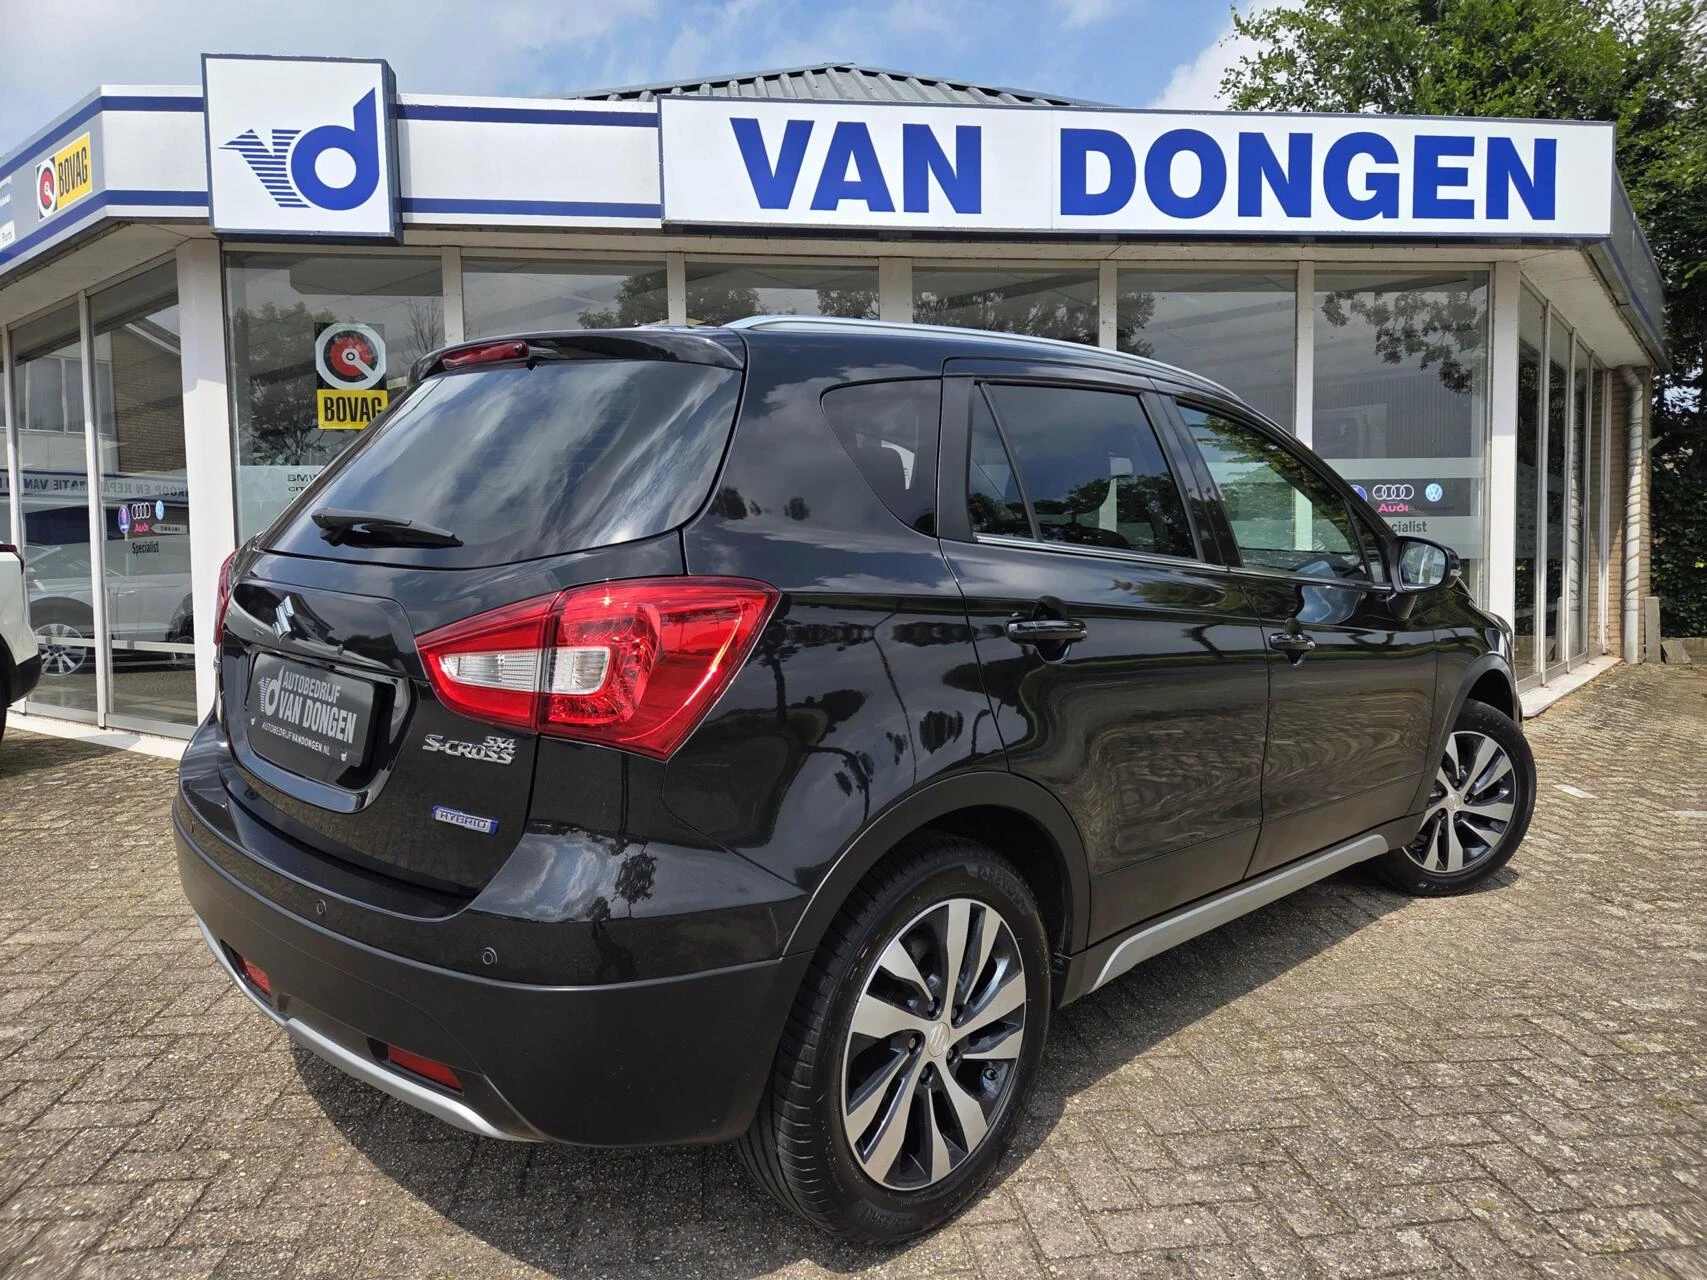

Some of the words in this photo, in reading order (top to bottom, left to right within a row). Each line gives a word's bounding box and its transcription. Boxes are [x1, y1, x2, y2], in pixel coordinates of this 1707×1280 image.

[58, 146, 88, 197] BOVAG
[730, 117, 982, 214] VAN
[1059, 128, 1557, 221] DONGEN
[1378, 503, 1409, 512] Audi
[1391, 521, 1427, 533] cialist
[131, 540, 159, 556] Specialist
[282, 671, 341, 703] AUTOBEDRIJF
[278, 690, 303, 725] VAN
[302, 698, 357, 744] DONGEN
[261, 721, 331, 756] AUTOBEDRIJFVANDONGEN.NL
[422, 733, 515, 765] S-CROSS
[483, 735, 516, 750] SX4
[439, 811, 487, 829] HYBRID
